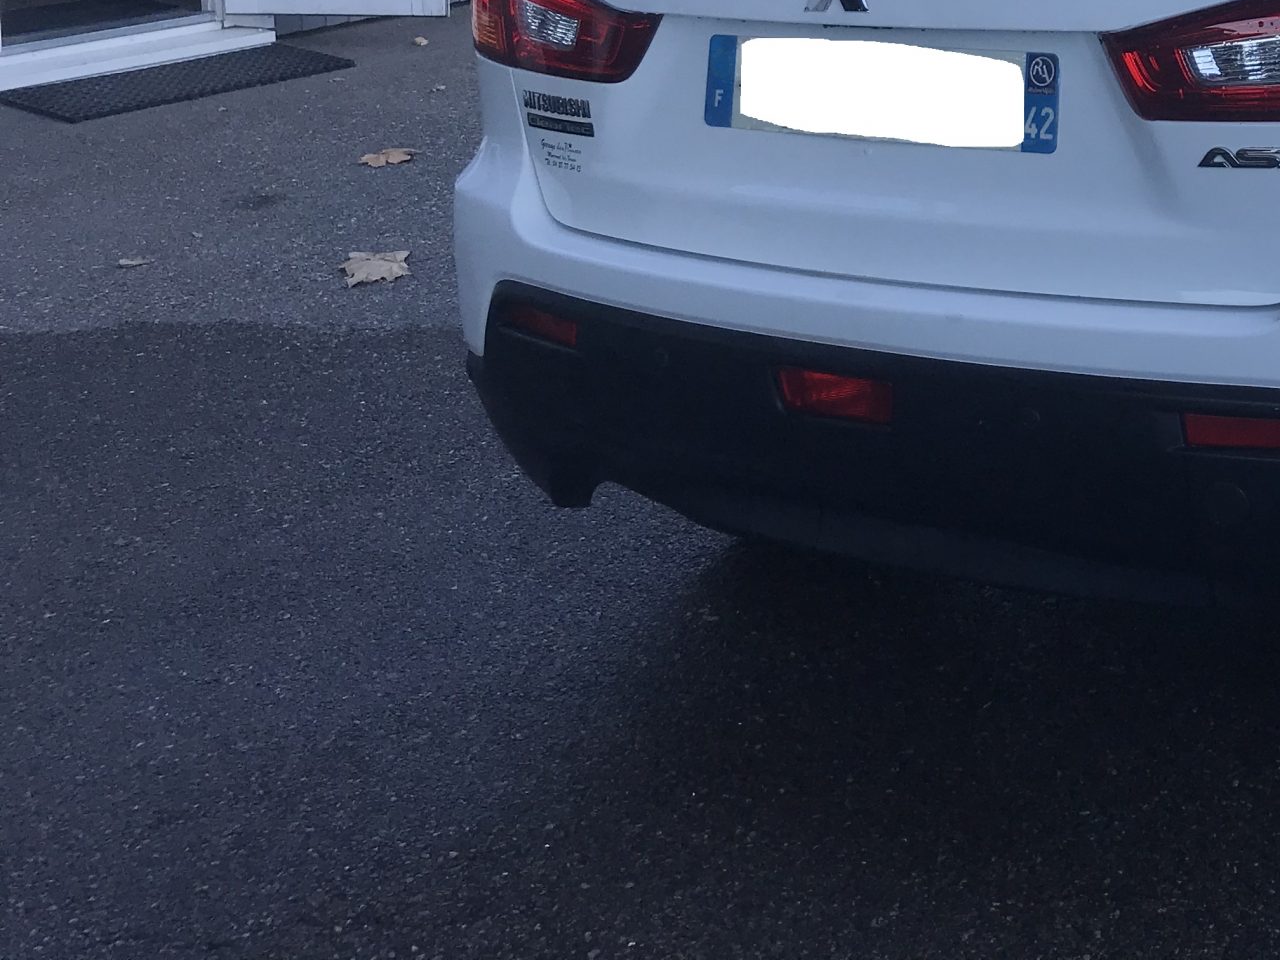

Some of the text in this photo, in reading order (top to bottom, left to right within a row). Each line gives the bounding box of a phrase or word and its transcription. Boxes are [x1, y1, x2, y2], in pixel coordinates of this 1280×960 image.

[522, 89, 592, 119] MITSUBISHI
[714, 89, 724, 107] F
[1024, 106, 1055, 140] 42
